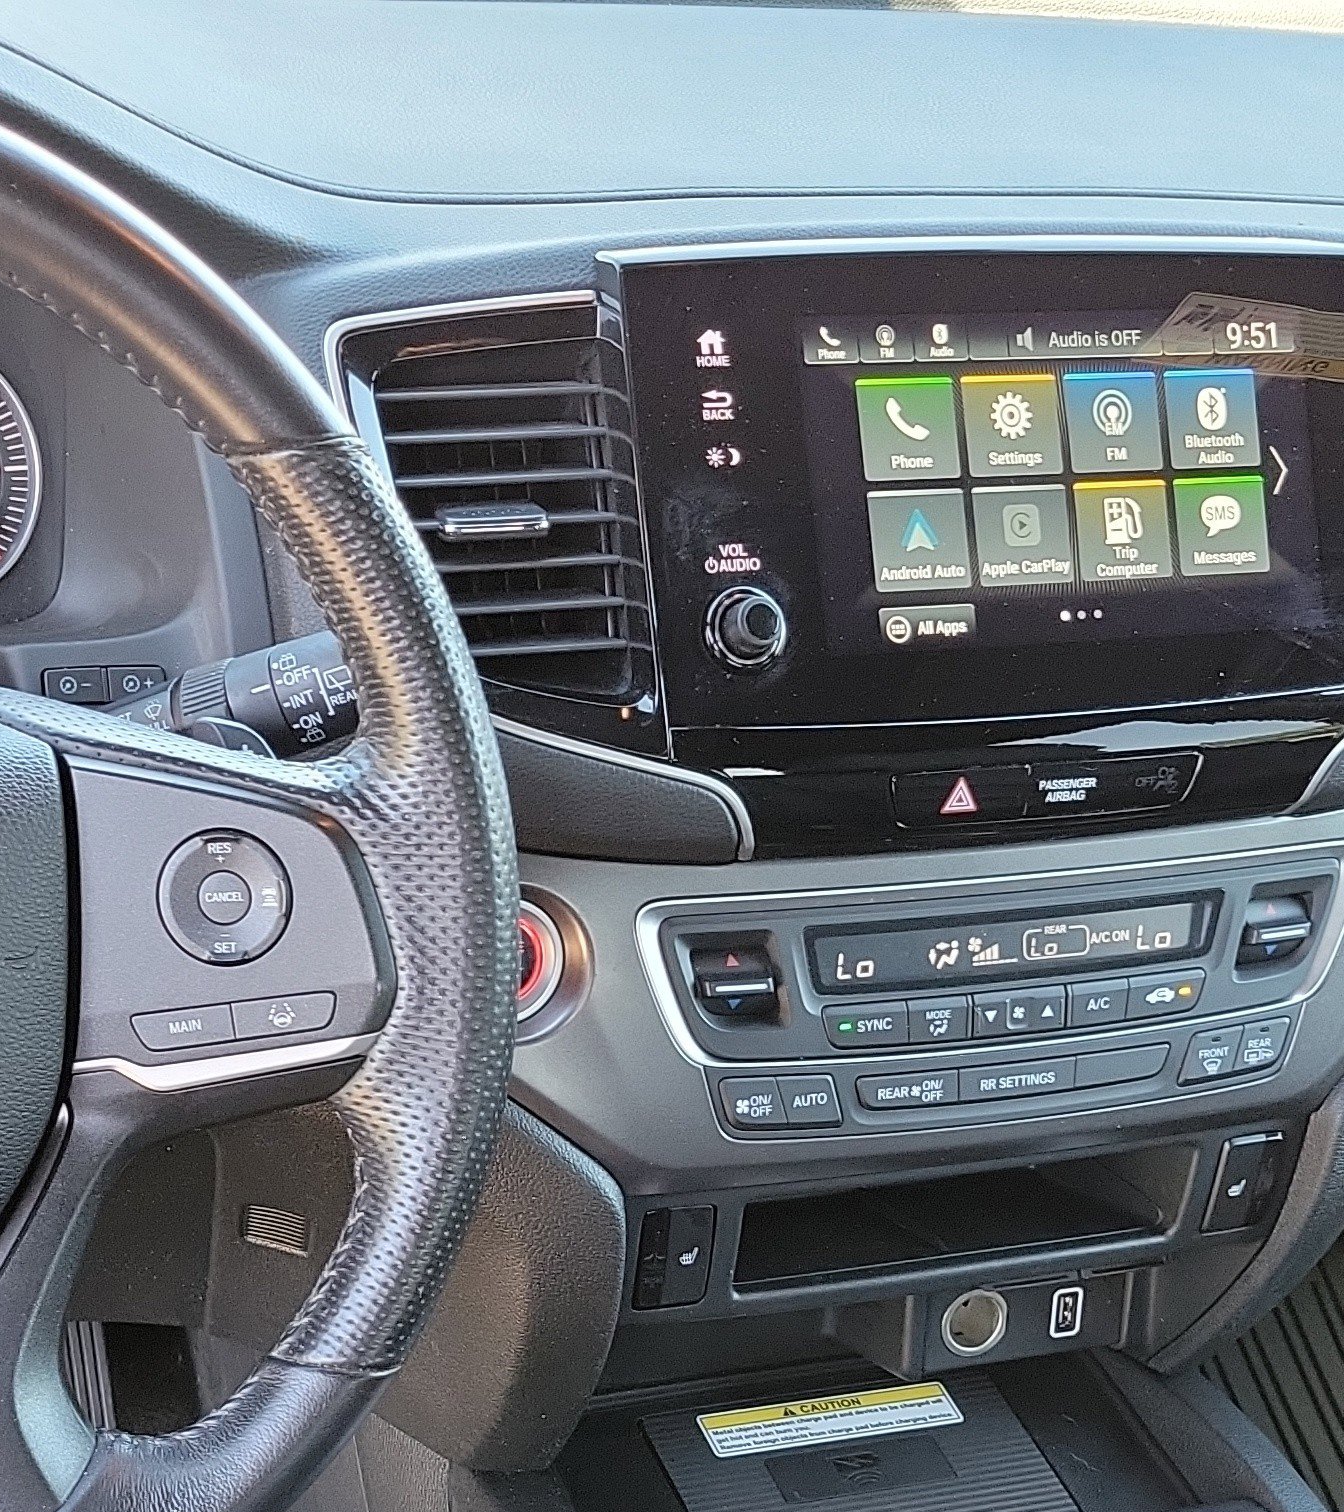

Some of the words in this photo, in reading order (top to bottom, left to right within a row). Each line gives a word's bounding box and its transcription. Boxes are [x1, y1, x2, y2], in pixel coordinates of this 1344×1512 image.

[1048, 331, 1092, 348] Audio
[1095, 331, 1108, 347] is
[1111, 330, 1142, 346] OFF
[1226, 321, 1279, 350] 9:51
[817, 348, 846, 360] Phone
[880, 347, 895, 358] FM
[930, 346, 955, 358] Audio
[696, 355, 731, 367] HOME
[702, 408, 734, 421] BACK
[1184, 432, 1244, 448] Bluetooth
[988, 451, 1043, 467] Settings
[1106, 447, 1128, 460] FM
[1198, 450, 1234, 465] Audio
[891, 455, 934, 469] Phone
[1206, 506, 1235, 521] SMS
[719, 543, 748, 557] VOL
[1113, 546, 1139, 560] Trip
[718, 557, 761, 573] AUDIO
[1193, 551, 1257, 566] Messages
[880, 564, 932, 581] Android
[934, 564, 966, 578] Auto
[982, 561, 1020, 578] Apple
[1021, 559, 1071, 575] CarPlay
[1096, 562, 1158, 578] Computer
[917, 620, 935, 636] All
[936, 619, 968, 636] Apps
[283, 665, 311, 686] OFF
[289, 689, 314, 709] INT
[299, 711, 323, 729] ON
[1038, 777, 1097, 791] PASSENGER
[1045, 789, 1086, 803] AIRBAG
[207, 842, 232, 854] RES
[205, 891, 244, 903] CANCEL
[1044, 924, 1067, 935] REAR
[1090, 931, 1112, 945] A/C
[1112, 929, 1130, 943] ON
[1136, 924, 1171, 950] Lo
[214, 942, 237, 954] SET
[1030, 936, 1058, 957] Lo
[836, 953, 875, 981] Lo
[1087, 996, 1110, 1011] A/C
[926, 1009, 952, 1020] MODE
[169, 1018, 203, 1035] MAIN
[857, 1017, 892, 1032] SYNC
[1247, 1037, 1272, 1049] REAR
[1198, 1046, 1229, 1059] FRONT
[922, 1078, 944, 1090] ON/
[980, 1078, 996, 1091] RR
[998, 1072, 1055, 1089] SETTINGS
[750, 1094, 772, 1107] ON/
[793, 1092, 827, 1108] AUTO
[877, 1086, 909, 1100] REAR
[921, 1089, 944, 1102] OFF
[750, 1105, 773, 1118] OFF
[800, 1398, 861, 1413] CAUTION
